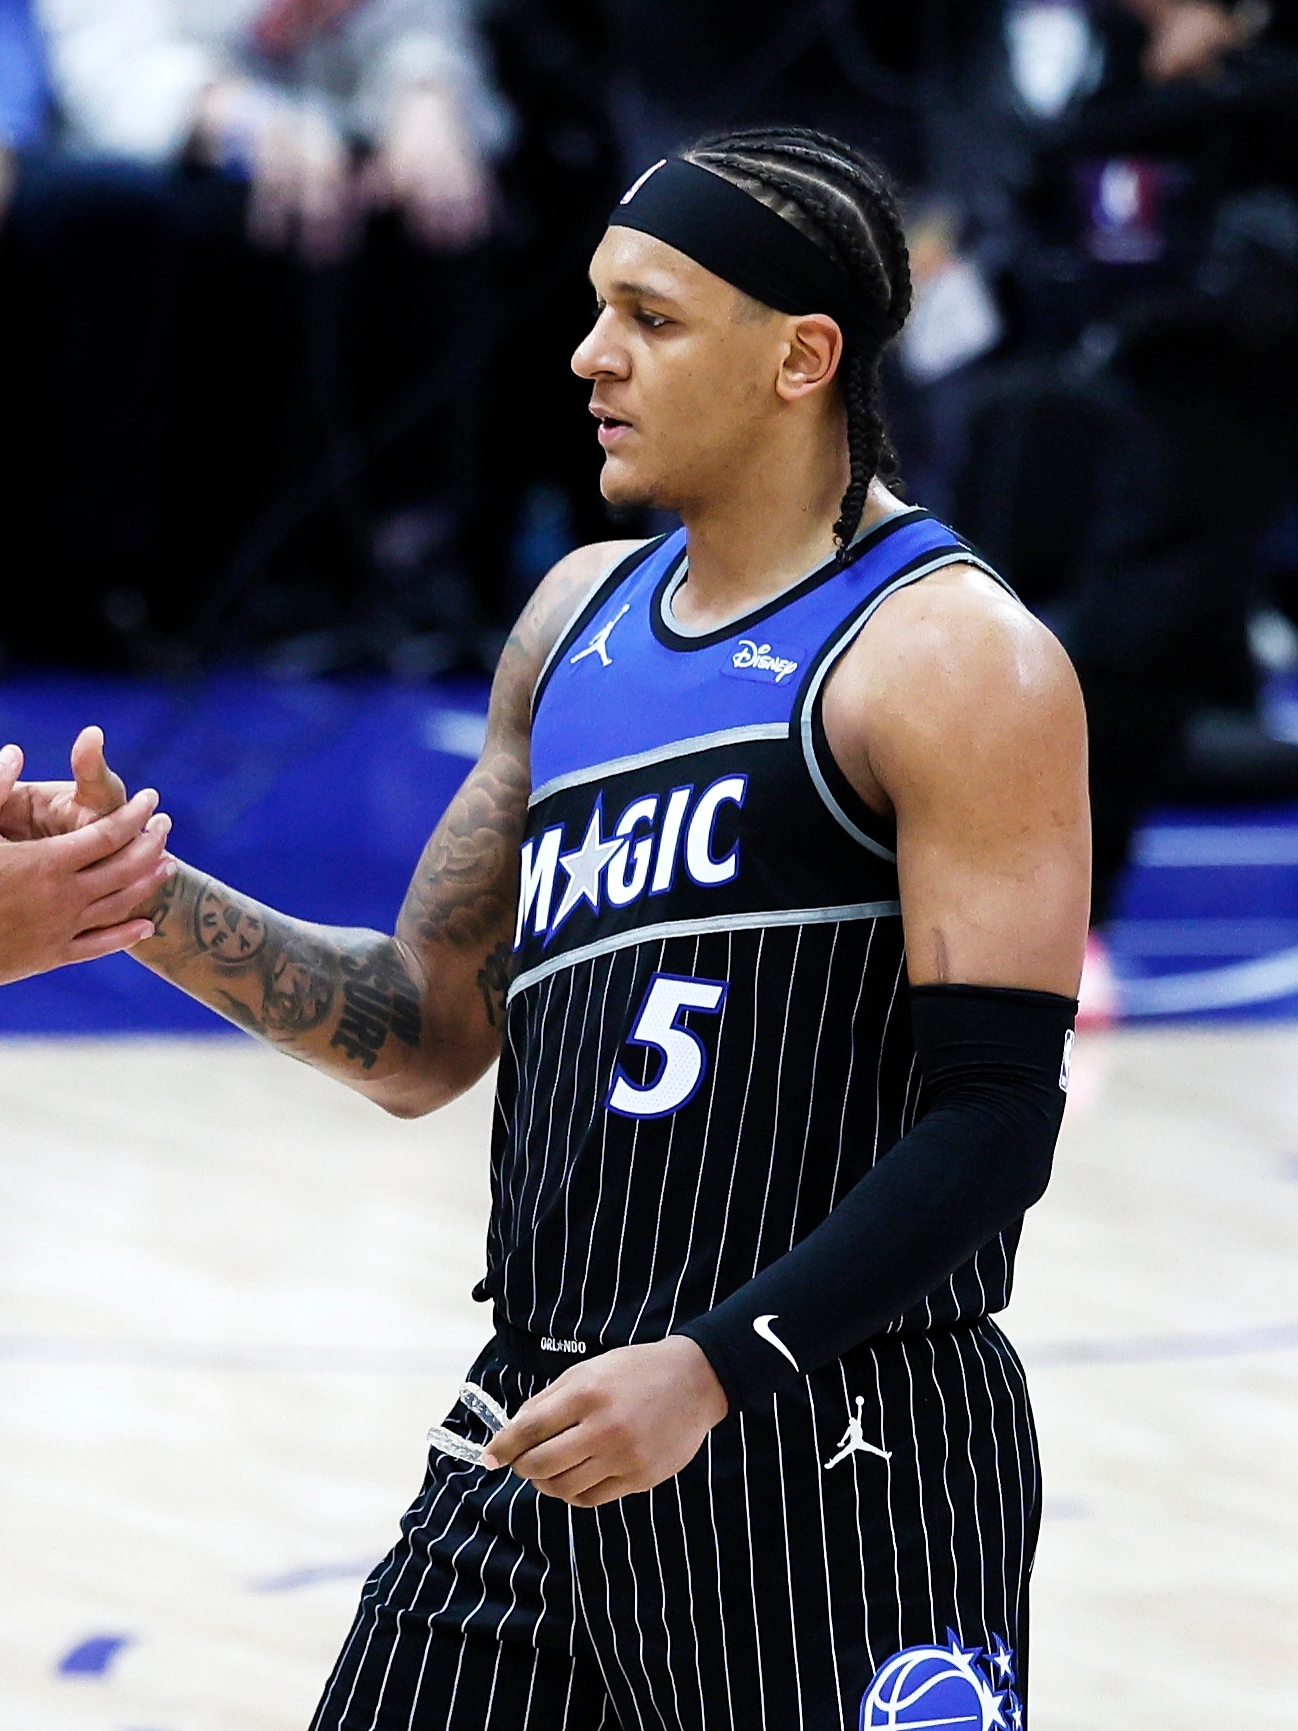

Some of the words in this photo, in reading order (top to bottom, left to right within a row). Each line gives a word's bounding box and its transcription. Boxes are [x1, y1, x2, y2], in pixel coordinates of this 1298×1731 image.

[732, 639, 798, 683] Disney
[512, 773, 749, 953] MAGIC
[605, 972, 729, 1121] 5
